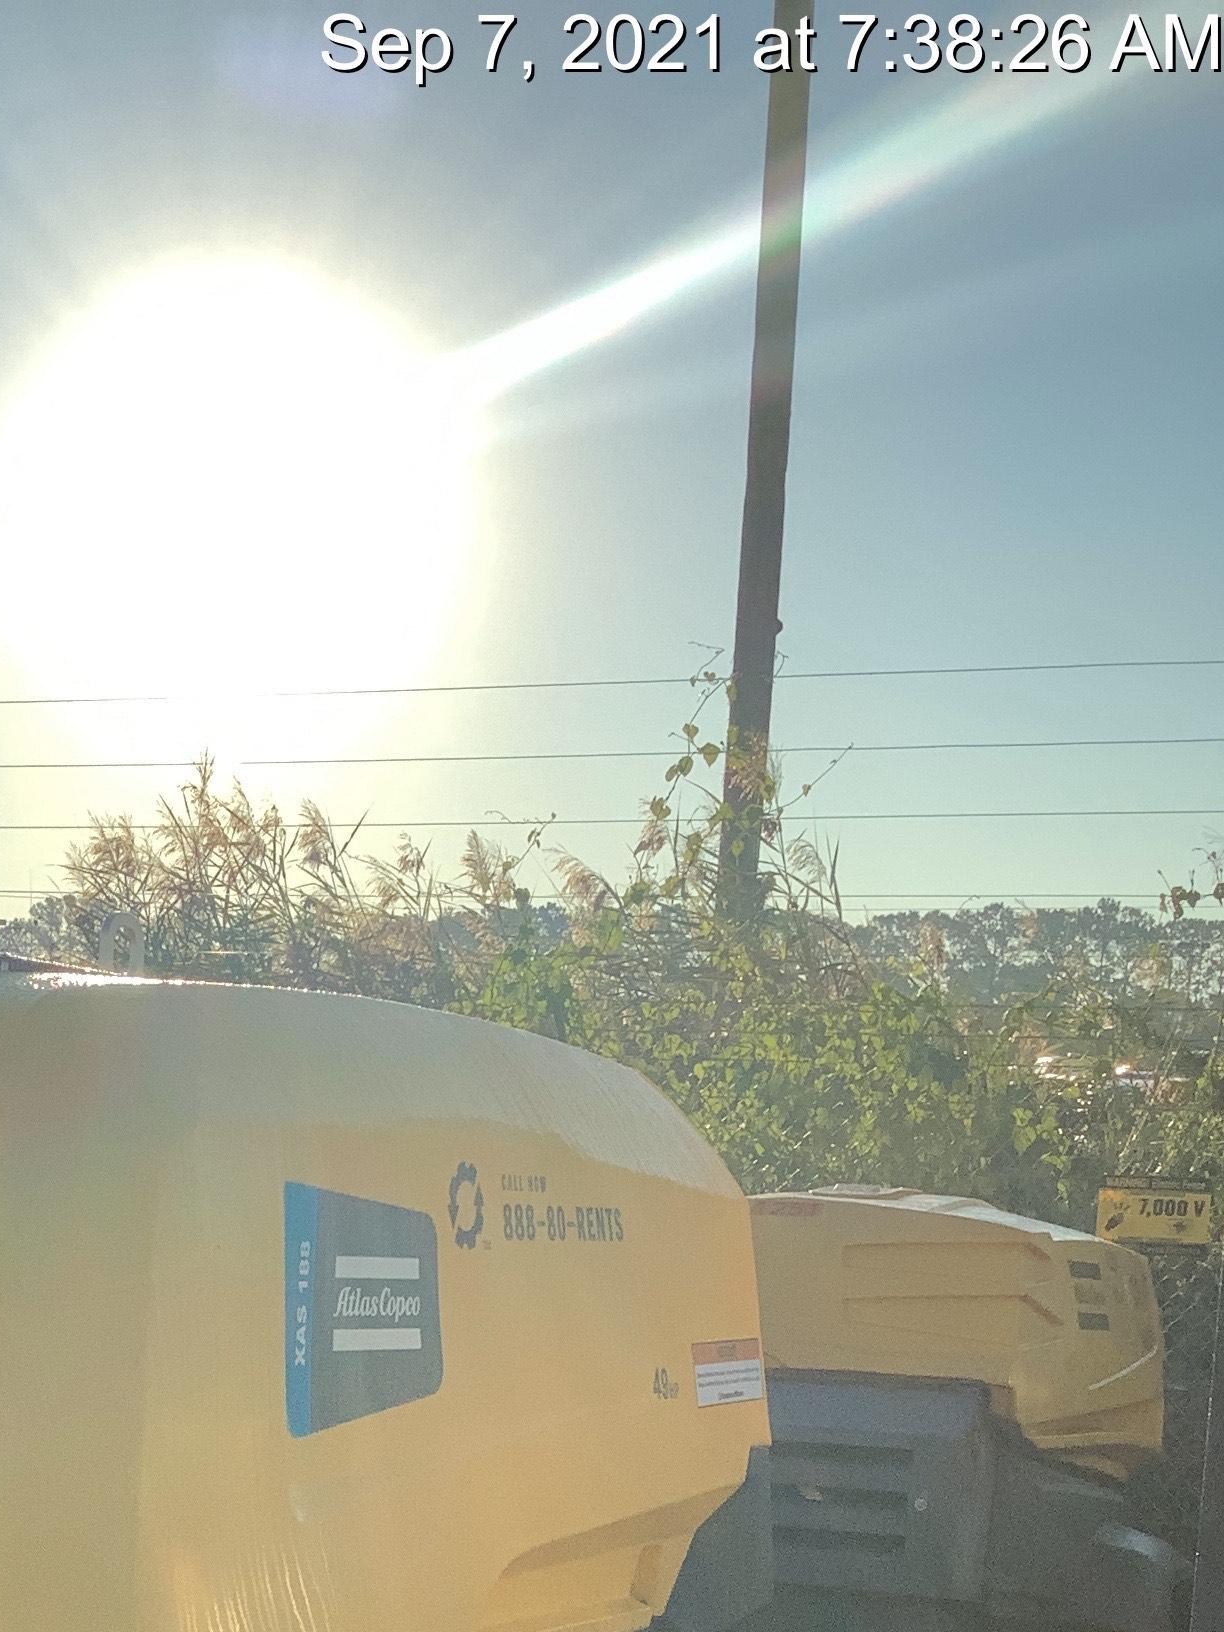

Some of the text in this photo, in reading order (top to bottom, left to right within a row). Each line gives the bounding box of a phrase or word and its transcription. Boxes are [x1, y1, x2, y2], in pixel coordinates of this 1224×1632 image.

[503, 1203, 624, 1242] 888-80-RENTS
[1138, 1198, 1206, 1218] 7,000 V
[294, 1305, 308, 1367] XAS
